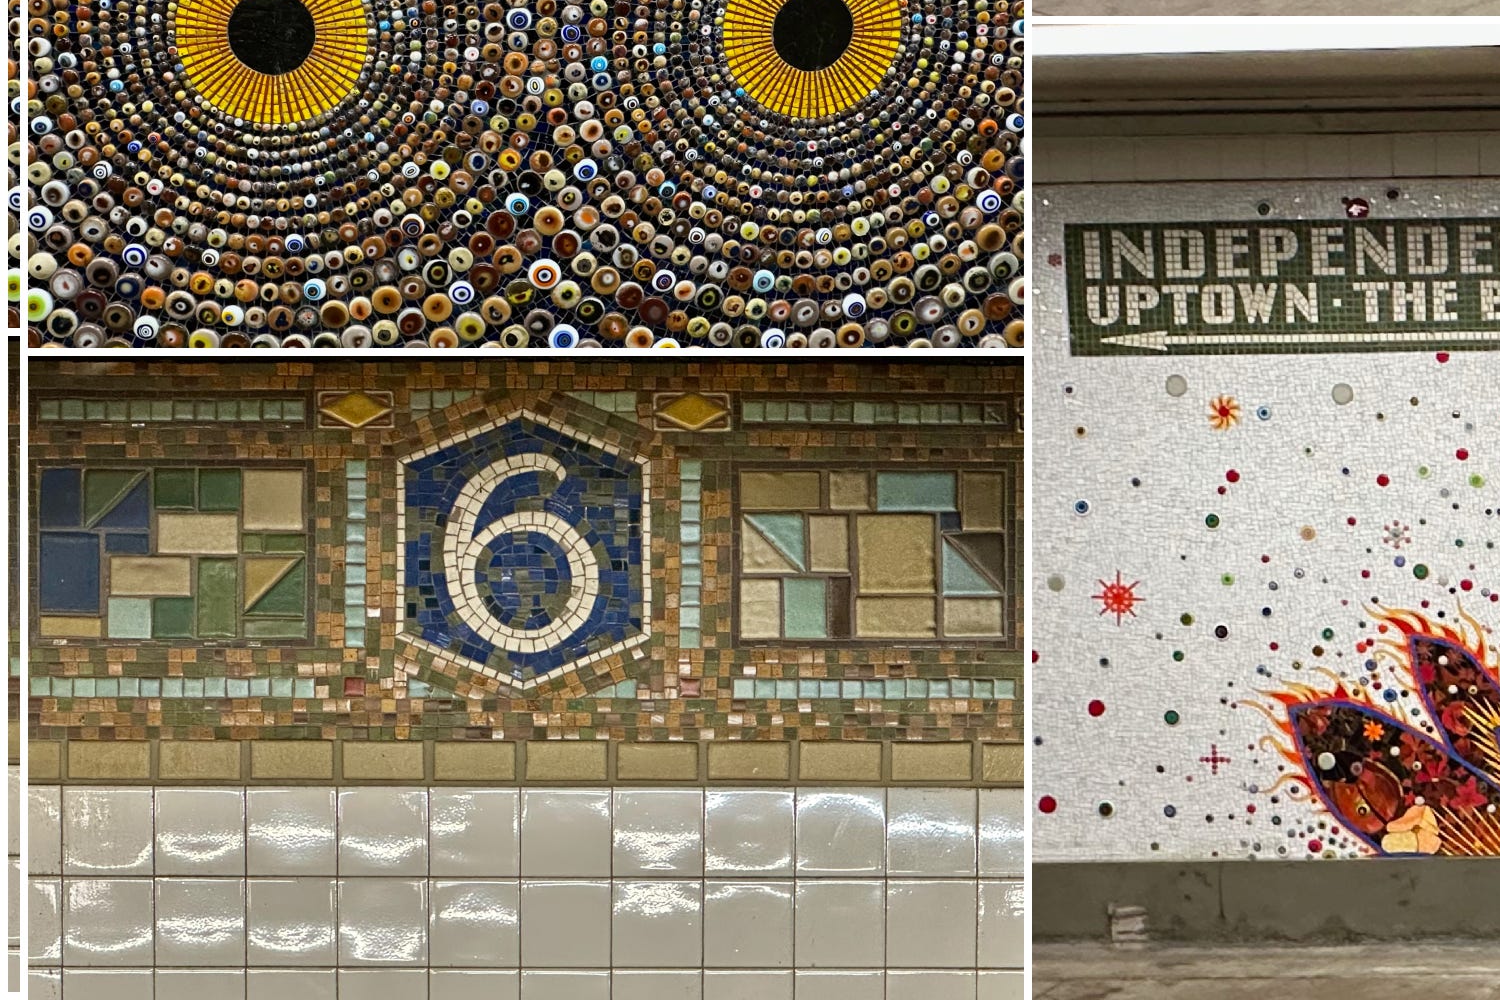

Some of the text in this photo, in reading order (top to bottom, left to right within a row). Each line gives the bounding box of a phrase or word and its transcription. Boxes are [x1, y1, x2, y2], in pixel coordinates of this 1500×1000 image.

[1086, 281, 1320, 326] UPTOWN
[1352, 280, 1459, 323] THE
[442, 453, 600, 654] 6
